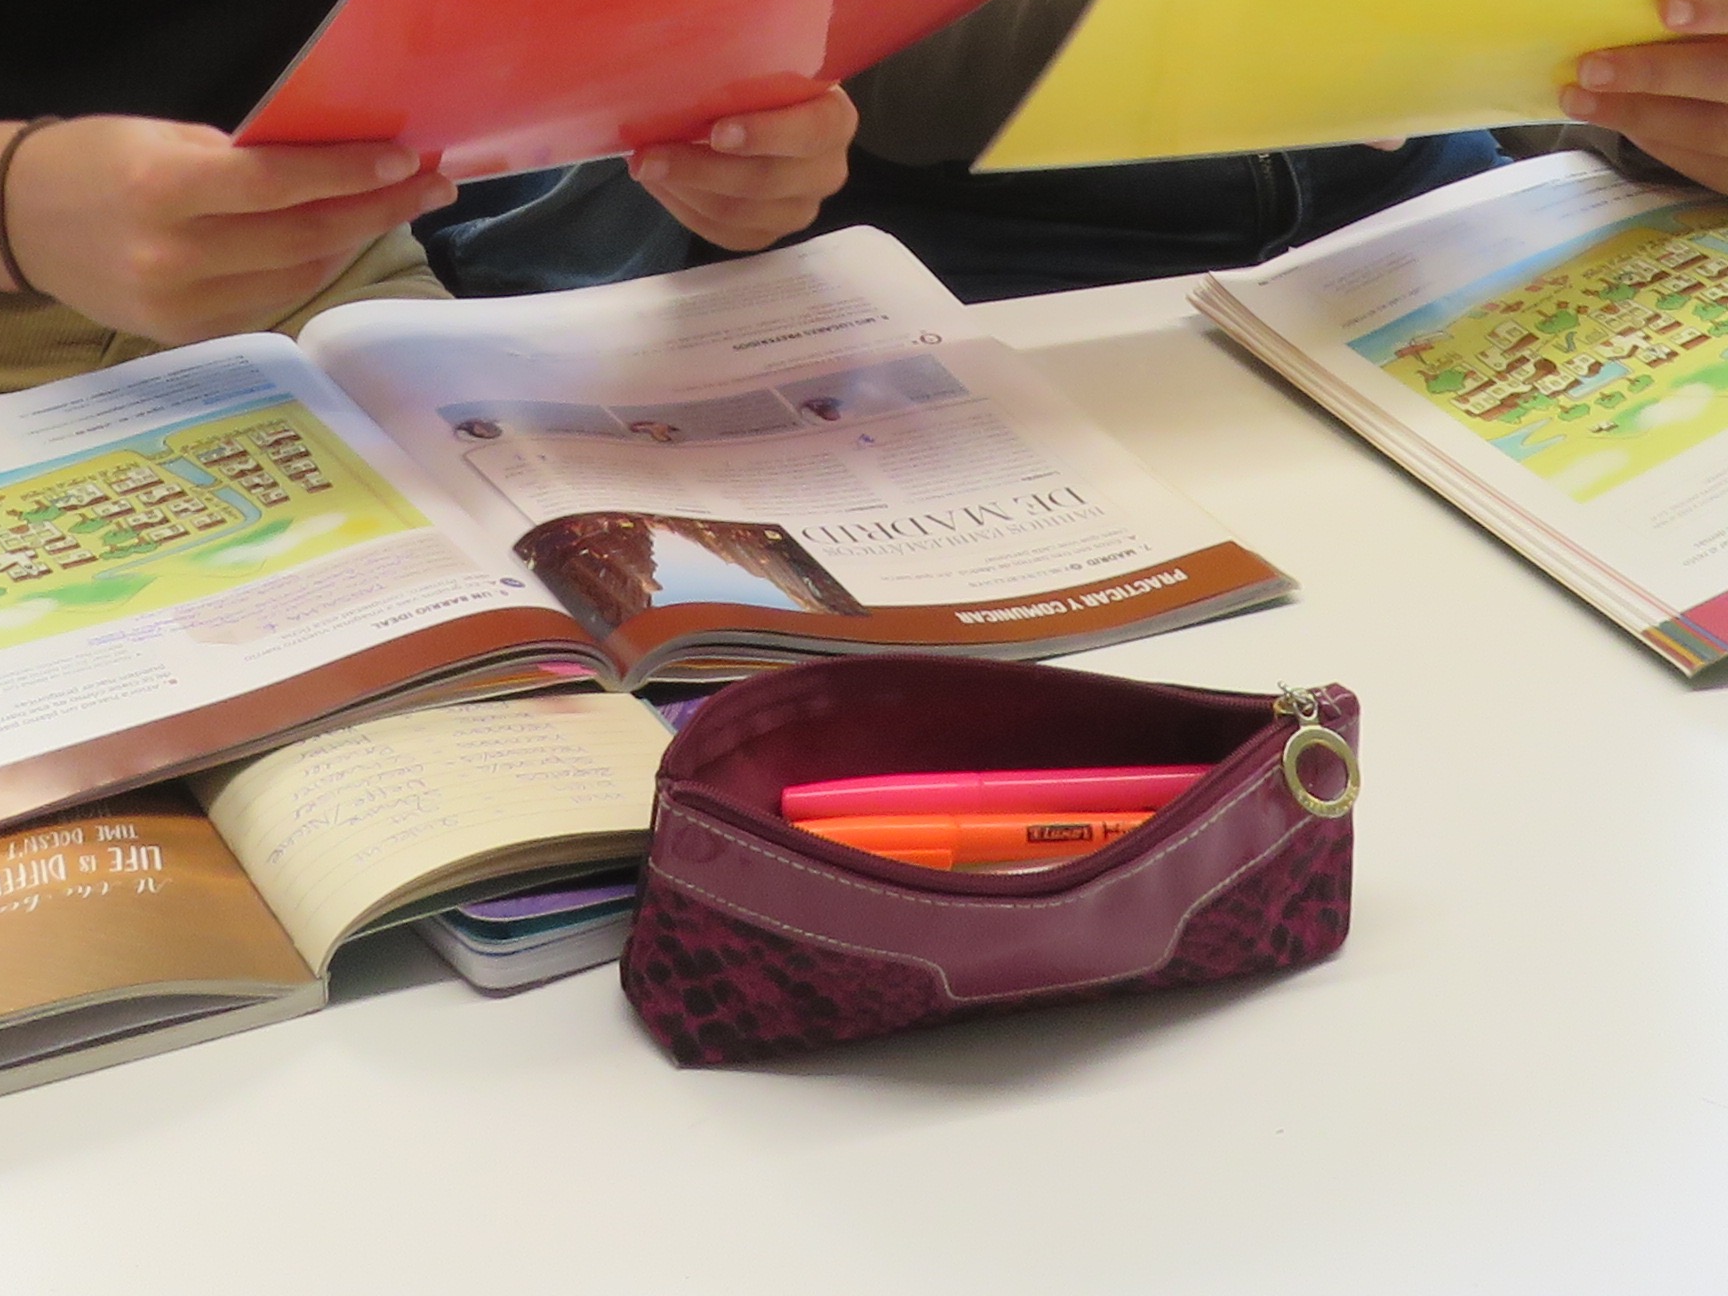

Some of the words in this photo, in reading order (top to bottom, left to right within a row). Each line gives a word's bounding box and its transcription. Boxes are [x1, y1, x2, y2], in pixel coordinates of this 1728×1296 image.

[1011, 485, 1086, 513] DE
[799, 501, 1013, 544] MADRID
[1005, 505, 1105, 535] BARRIOS
[1085, 547, 1137, 567] MADRID
[1079, 566, 1189, 610] PRACTICAR
[413, 592, 469, 618] BARRIO
[952, 598, 1068, 624] COMUNICAR
[1065, 595, 1083, 611] Y
[368, 609, 414, 632] IDEAL
[3, 825, 85, 861] DOESN'T
[93, 818, 139, 844] TIME
[103, 844, 164, 874] LIFE
